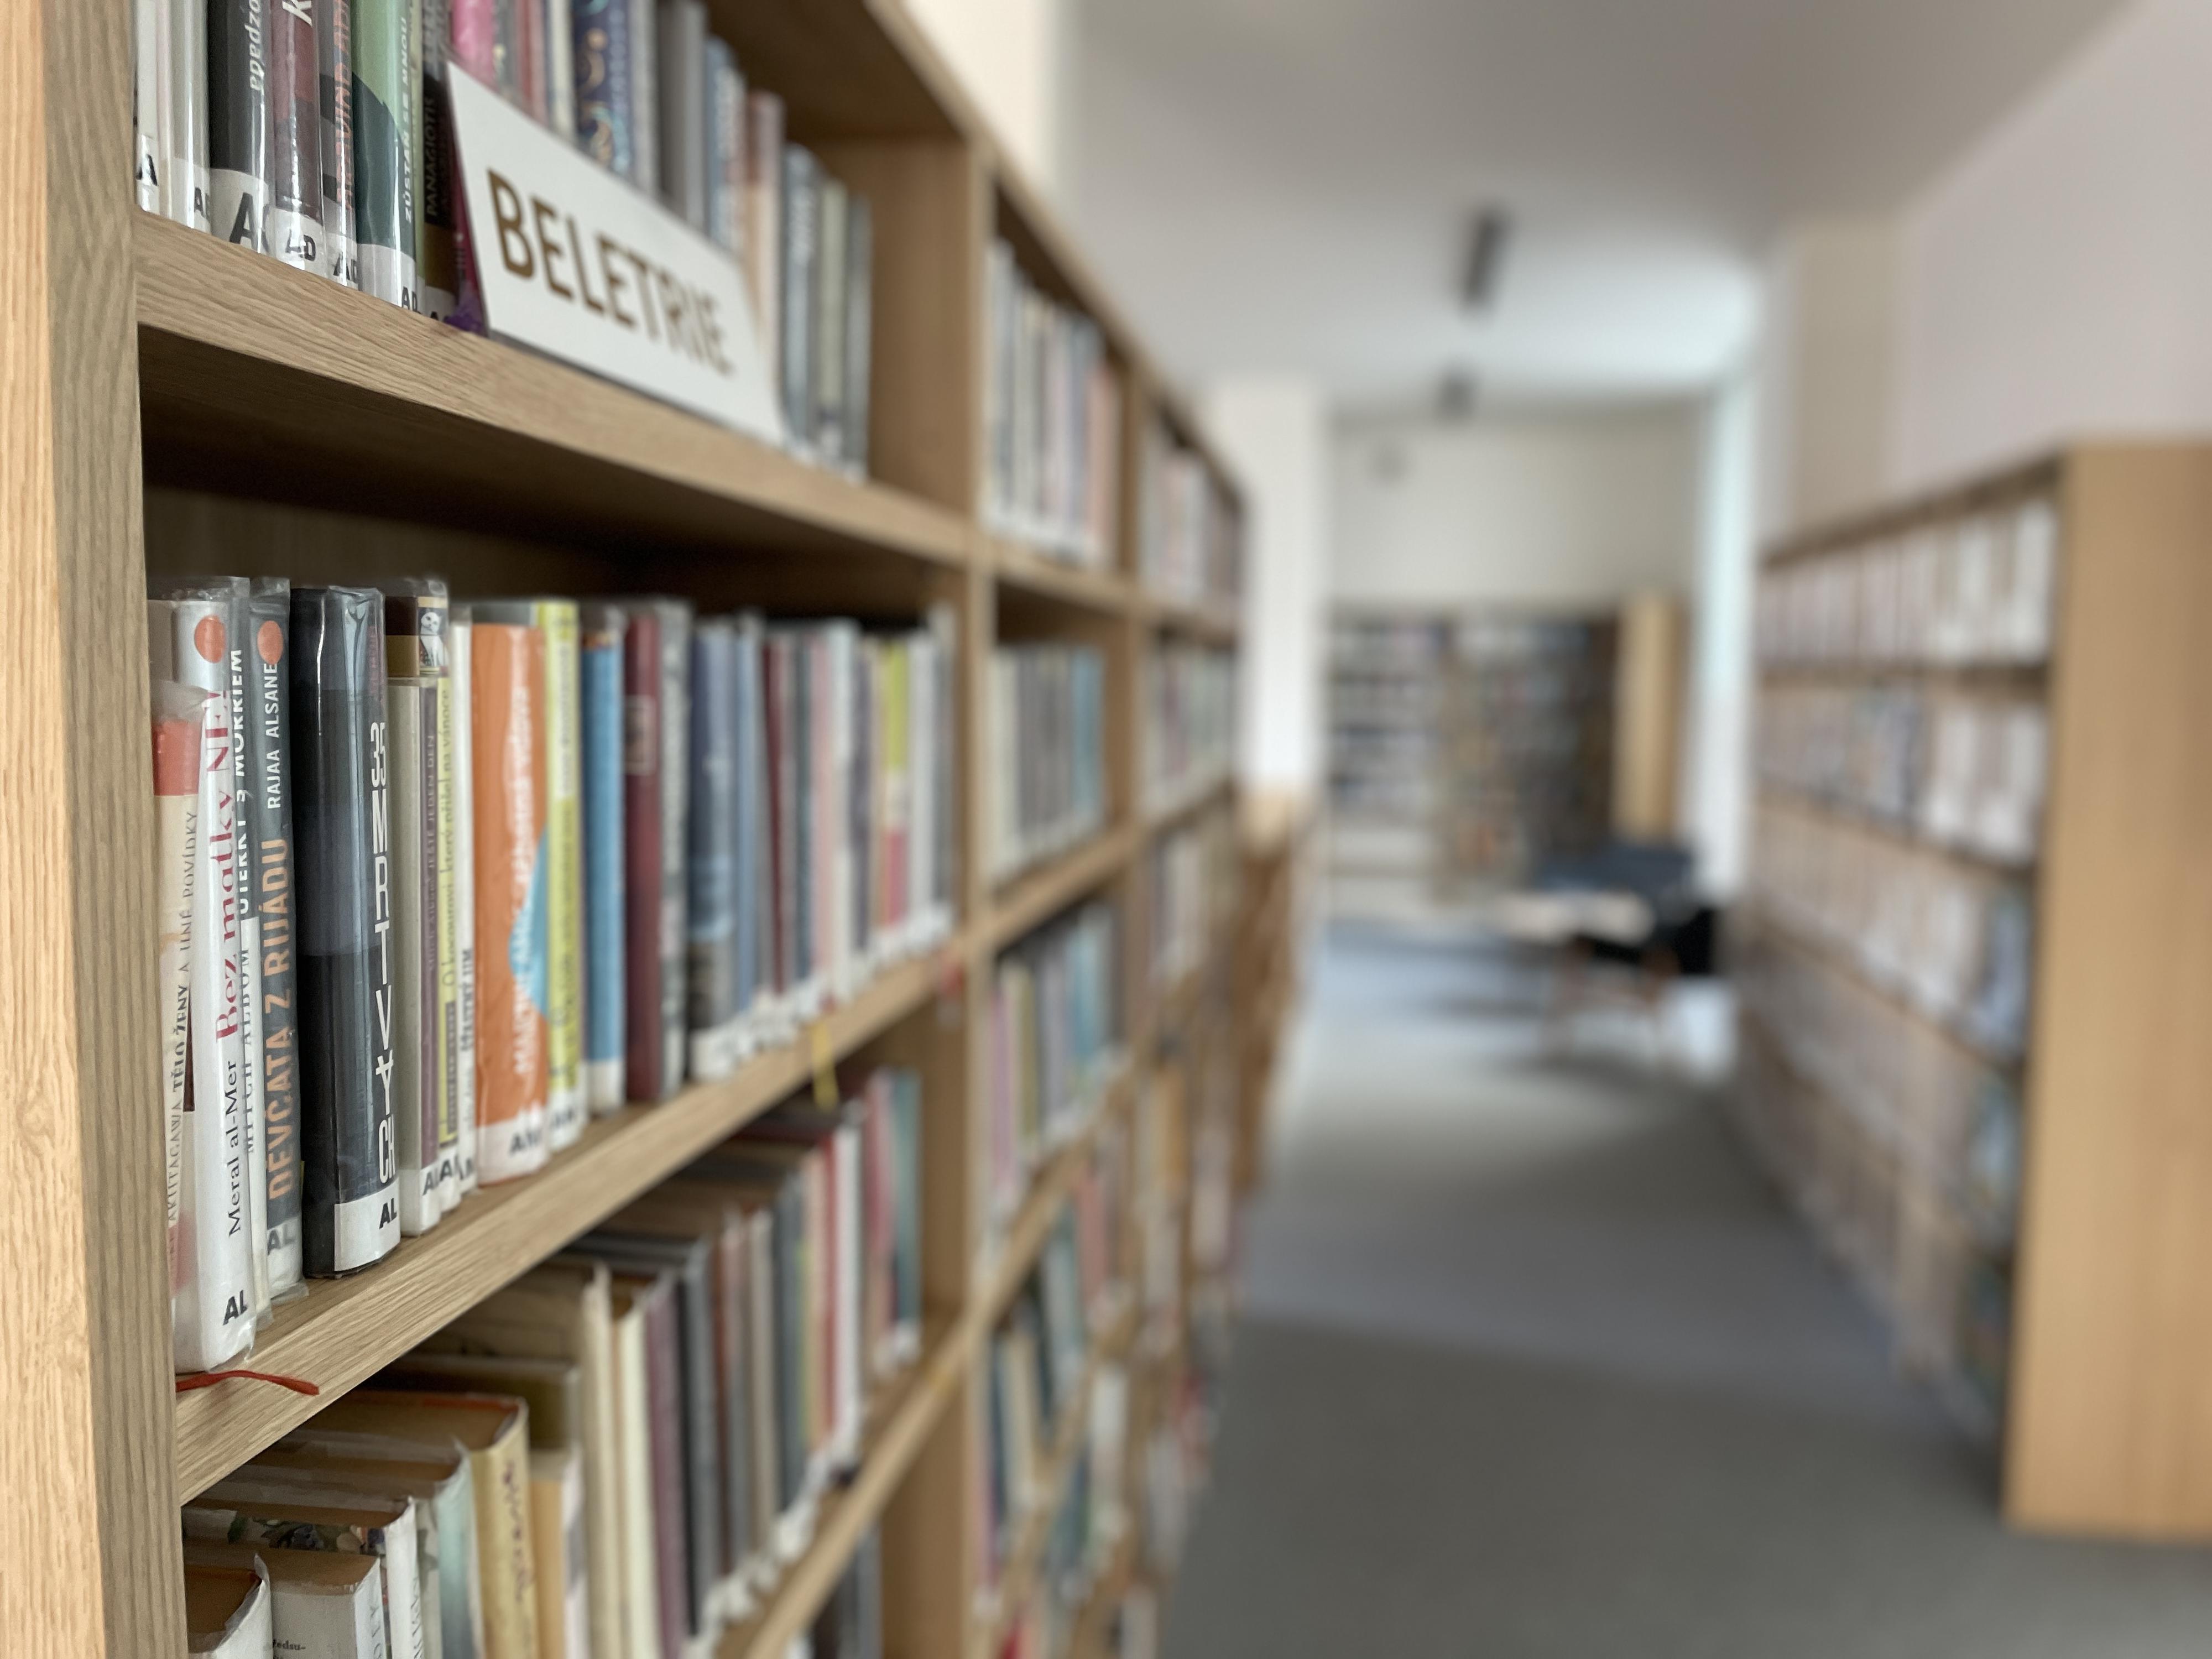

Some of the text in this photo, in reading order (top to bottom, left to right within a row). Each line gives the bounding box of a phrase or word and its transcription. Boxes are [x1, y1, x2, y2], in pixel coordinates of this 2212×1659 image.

[487, 168, 734, 376] BELETRIE
[266, 749, 281, 810] RAJAA
[371, 722, 385, 787] 35
[181, 812, 197, 898] POVÍDKY
[209, 790, 235, 945] matky
[257, 838, 290, 977] RIJÁDU
[215, 952, 238, 1043] Bez
[264, 989, 291, 1014] Z
[224, 1061, 239, 1149] al-Mer
[225, 1156, 241, 1239] Meral
[379, 1197, 397, 1229] AL
[268, 1229, 296, 1257] AL
[222, 1289, 248, 1327] AL
